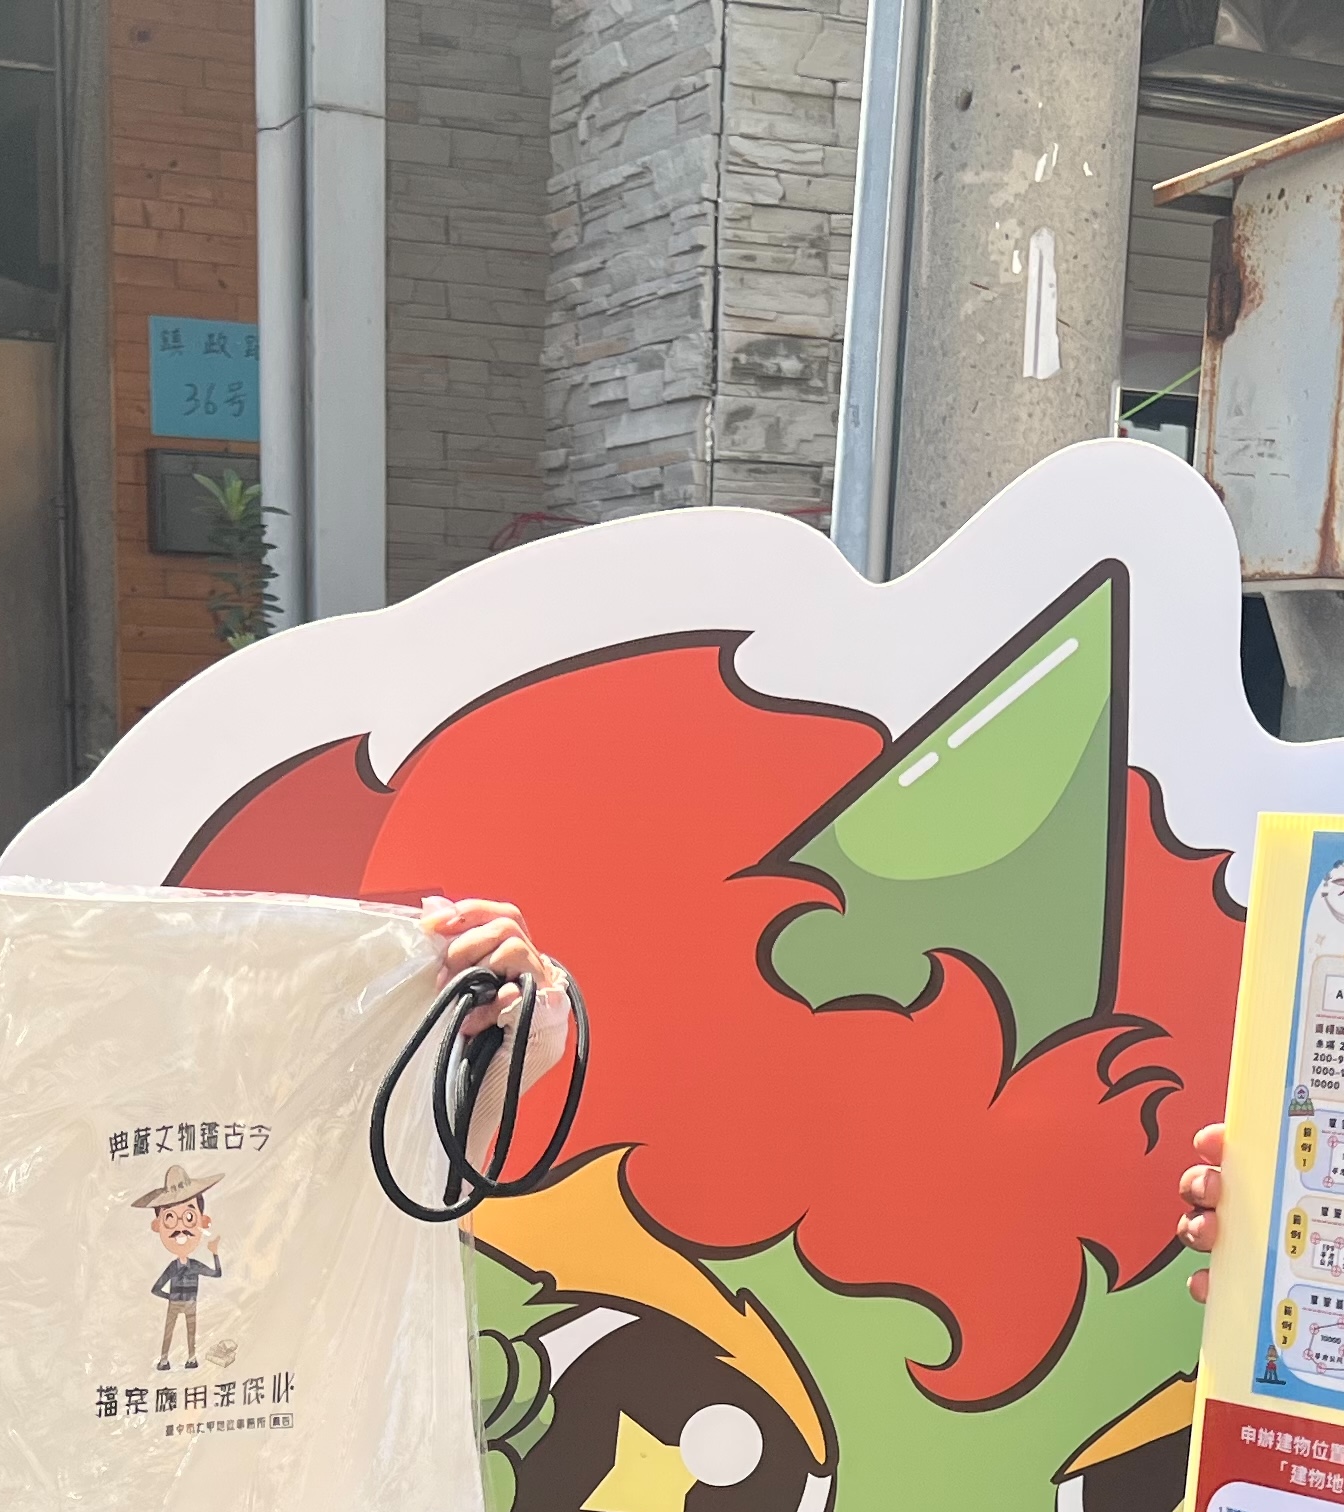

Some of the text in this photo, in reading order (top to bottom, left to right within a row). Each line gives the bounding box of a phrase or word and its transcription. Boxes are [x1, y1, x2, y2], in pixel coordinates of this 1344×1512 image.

[1335, 989, 1344, 999] A
[109, 1121, 272, 1162] 典藏文物鑑古今
